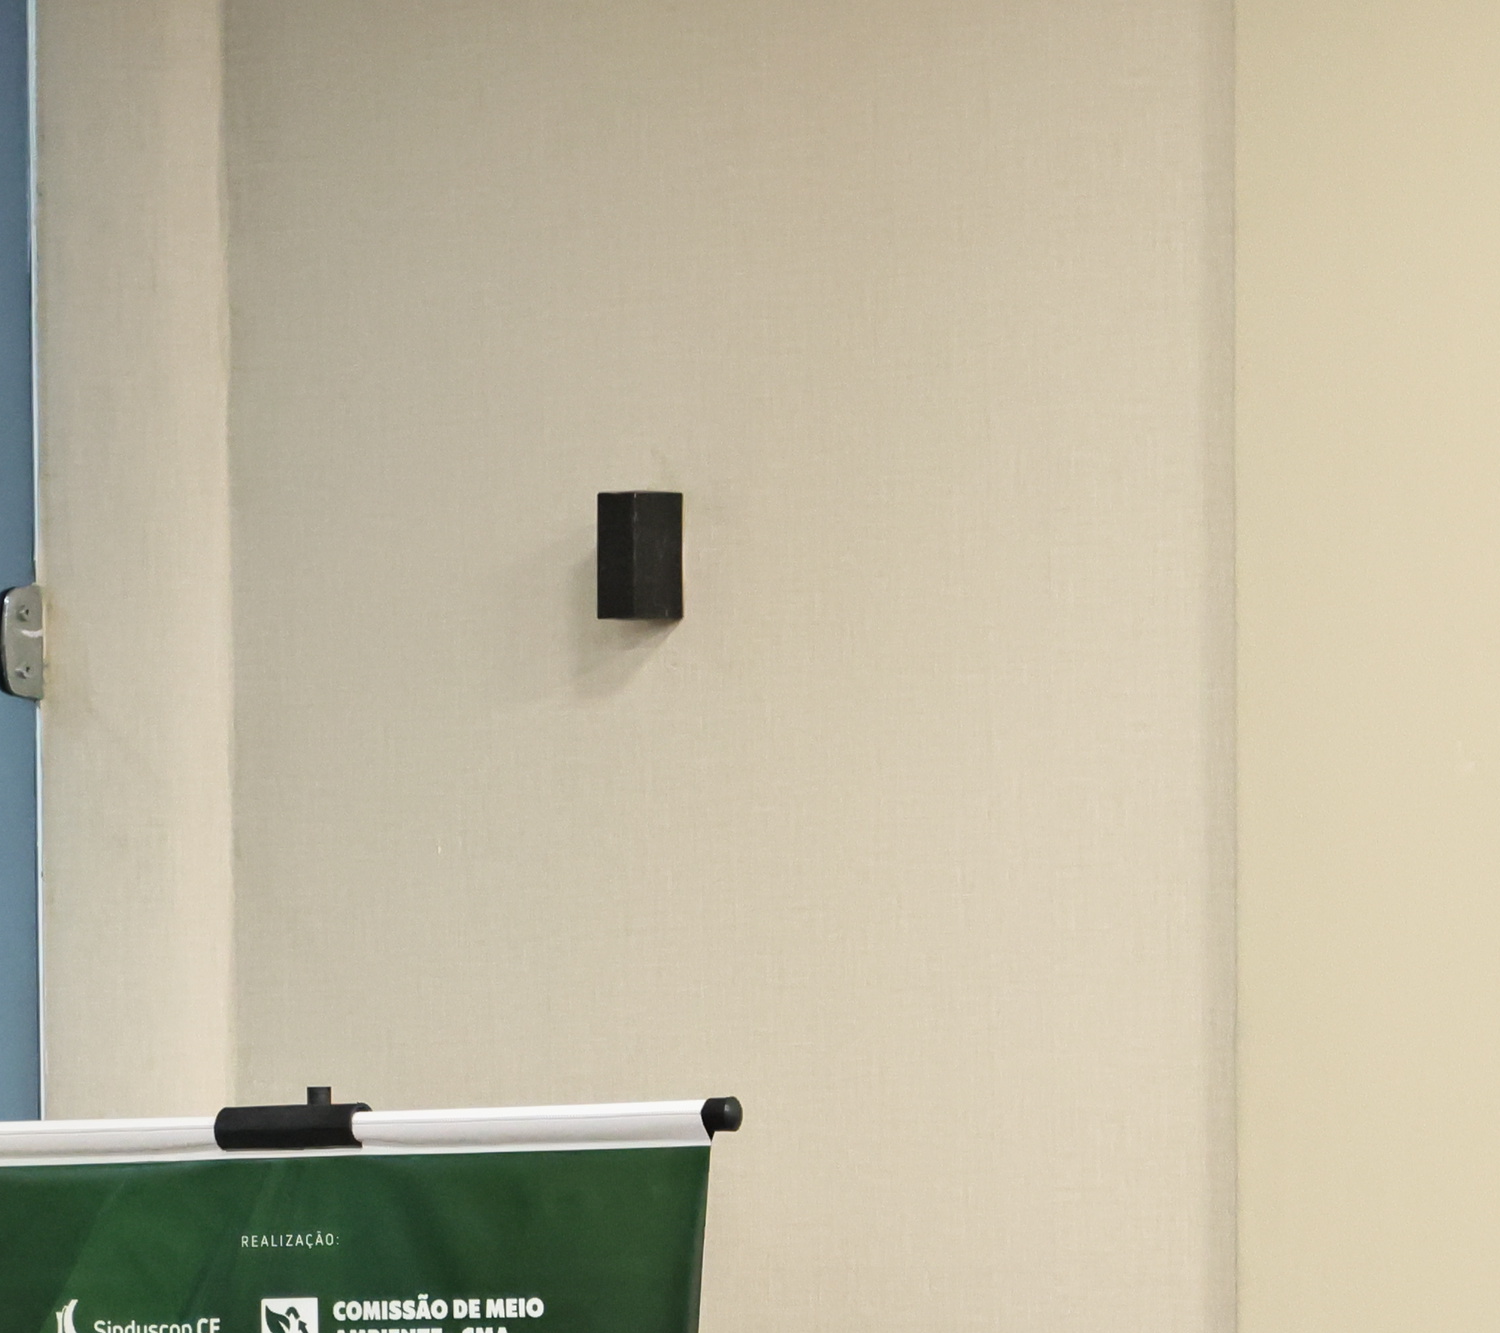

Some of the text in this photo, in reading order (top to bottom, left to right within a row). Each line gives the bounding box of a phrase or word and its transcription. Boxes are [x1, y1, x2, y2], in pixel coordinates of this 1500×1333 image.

[240, 1230, 341, 1250] REALIZAÇÃO:
[332, 1293, 545, 1322] COMISSÃO DE MEIO
